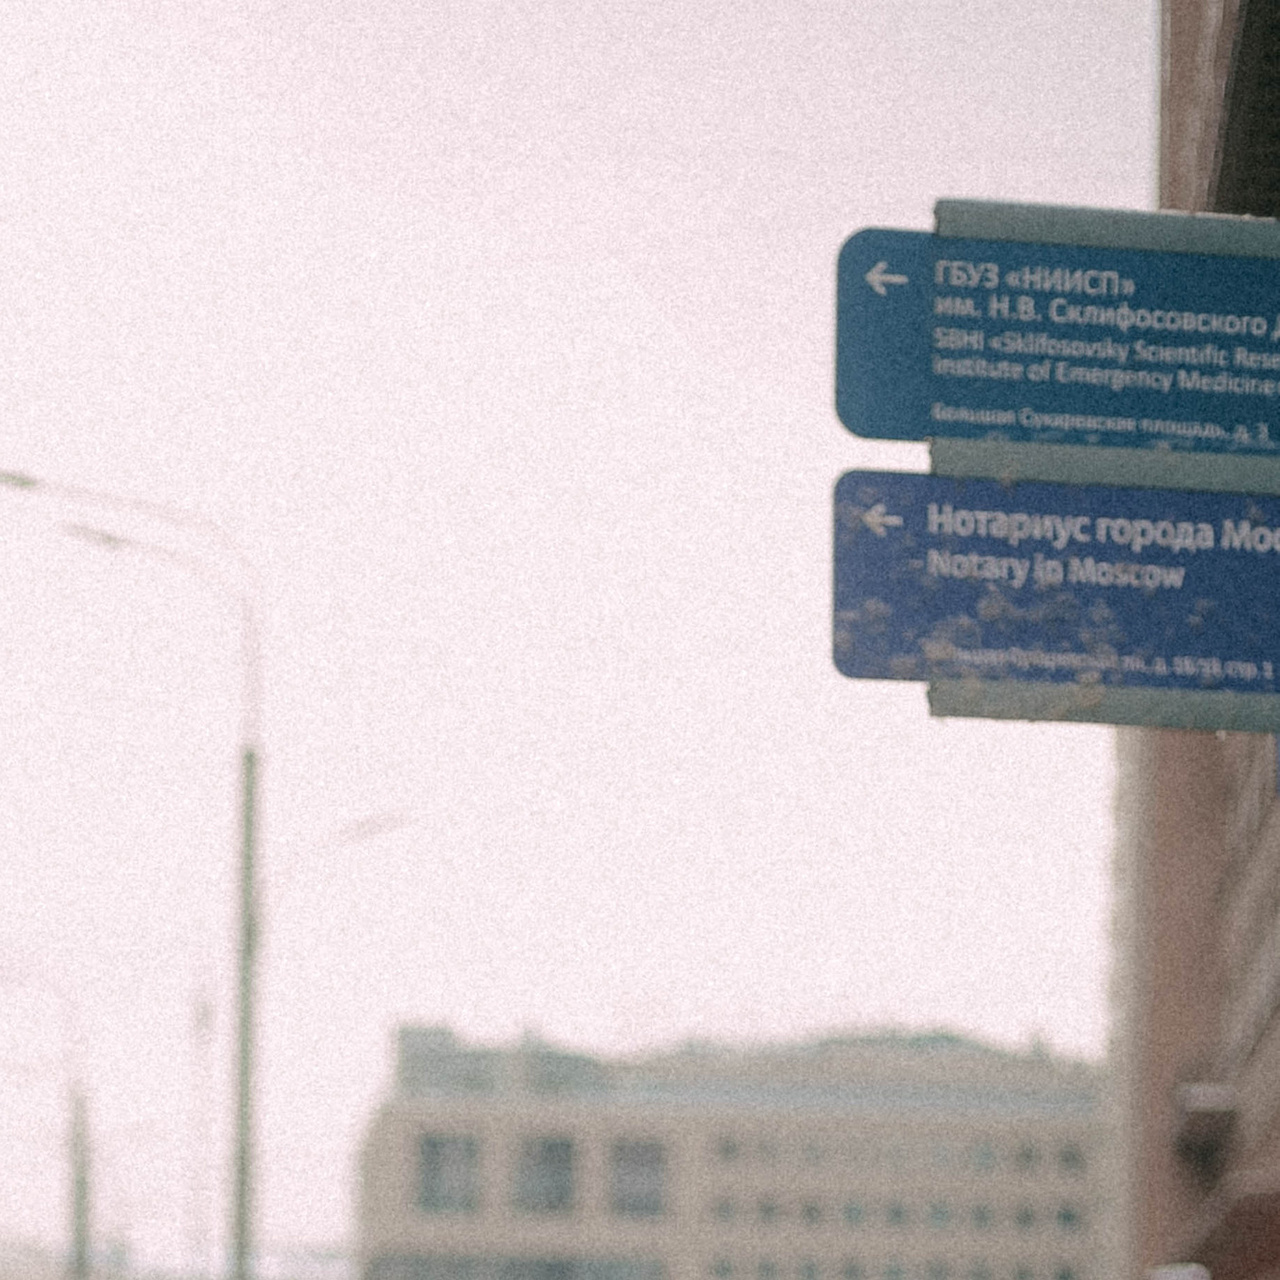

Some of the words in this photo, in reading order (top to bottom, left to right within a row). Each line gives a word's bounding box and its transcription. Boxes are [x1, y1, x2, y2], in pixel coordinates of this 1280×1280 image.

[934, 259, 999, 290] ГБУЗ
[1005, 265, 1135, 296] «НИИСП»
[933, 295, 982, 318] им.
[988, 294, 1043, 322] Н.В.
[1048, 297, 1268, 337] Склифосовского
[931, 353, 1024, 381] Institute
[1026, 360, 1051, 382] of
[1055, 361, 1174, 394] Emergency
[1176, 368, 1280, 395] Medicine
[1134, 339, 1230, 368] Scientific
[927, 502, 1091, 549] Нотариус
[1095, 516, 1215, 554] города
[927, 549, 1030, 589] Notary
[1068, 556, 1186, 589] Moscow
